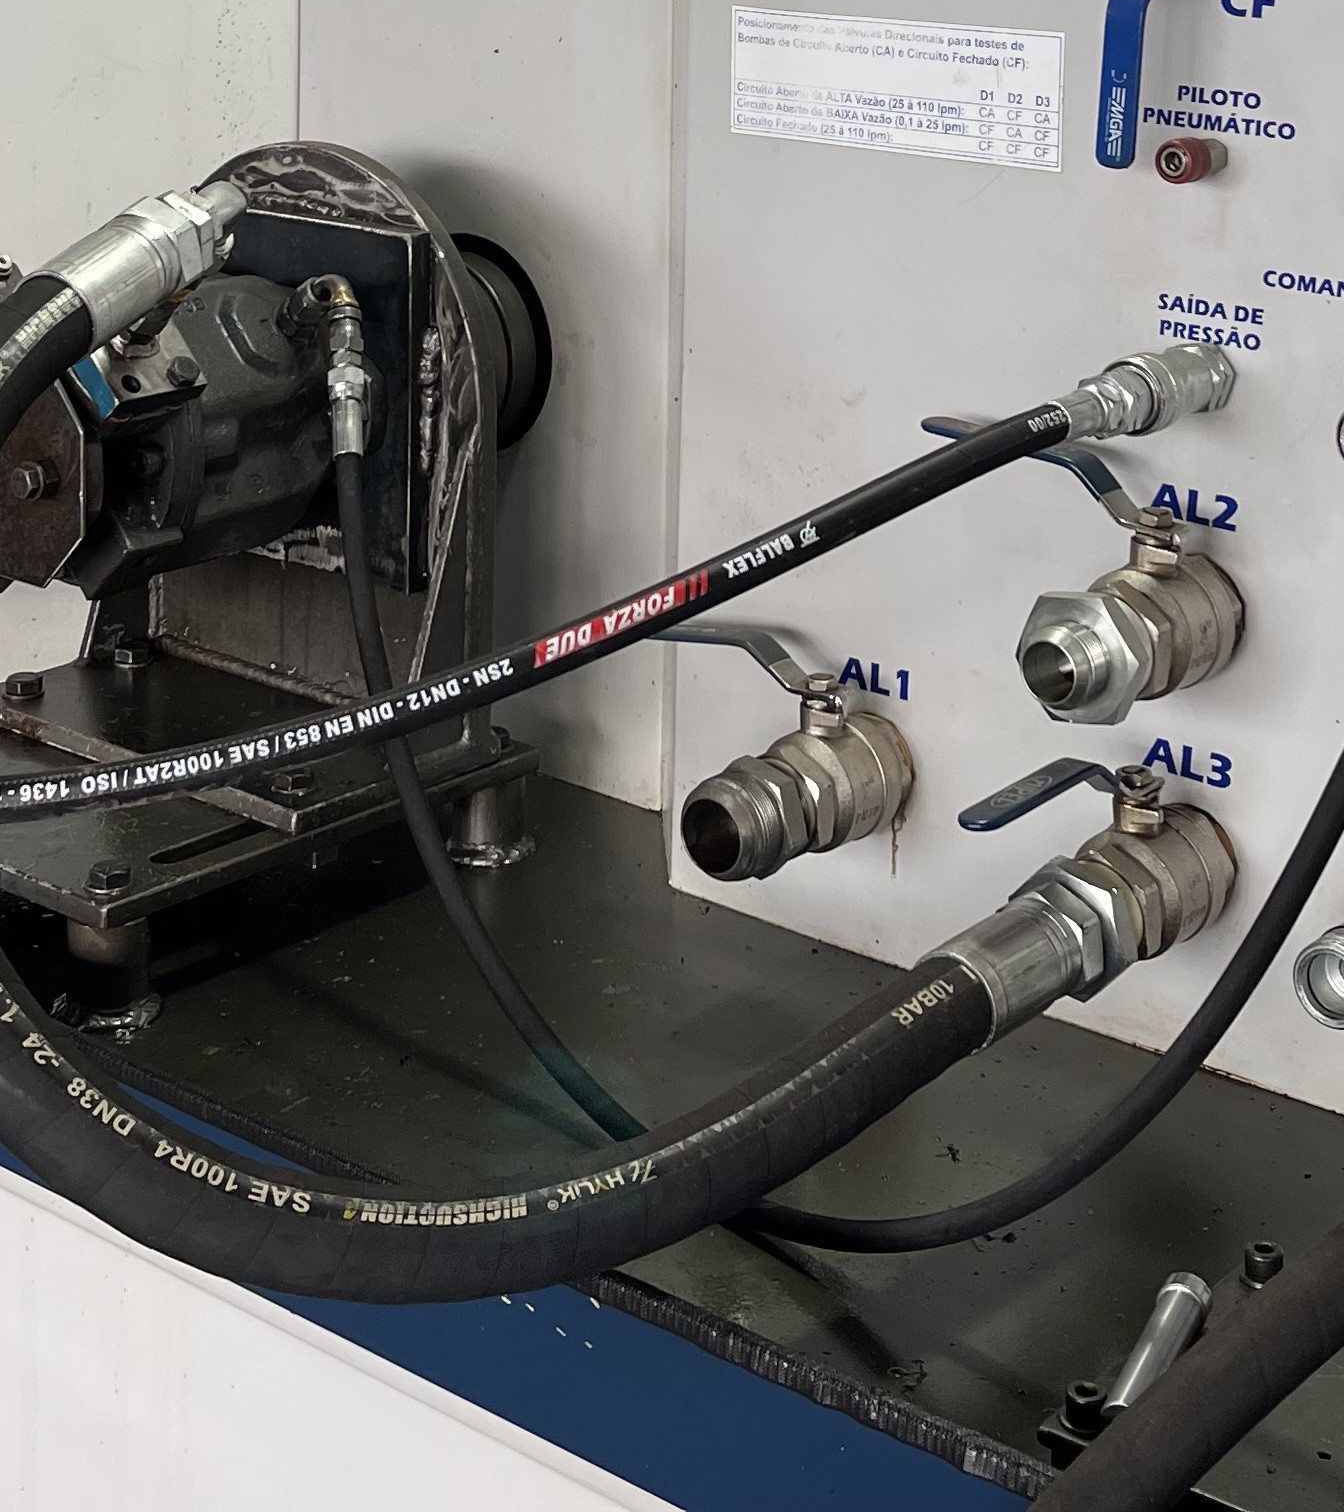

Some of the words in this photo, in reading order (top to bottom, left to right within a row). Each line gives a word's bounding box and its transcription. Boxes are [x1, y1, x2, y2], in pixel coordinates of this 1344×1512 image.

[738, 32, 776, 46] Bombas
[872, 45, 894, 59] (CA)
[907, 48, 949, 62] Circuito
[952, 52, 999, 66] Fechado
[947, 38, 971, 49] para
[974, 38, 1007, 49] testes
[1011, 40, 1025, 51] de
[737, 82, 773, 95] Circuito
[855, 93, 885, 107] Vazão
[889, 98, 904, 111] (25
[917, 101, 934, 112] 110
[980, 90, 994, 101] D1
[1008, 92, 1022, 104] D2
[1035, 96, 1050, 107] D3
[1177, 85, 1260, 109] PILOTO
[861, 111, 892, 124] Vazão
[926, 119, 938, 129] 25
[979, 107, 995, 118] CA
[1007, 110, 1023, 120] CF
[1035, 113, 1050, 124] CA
[1143, 107, 1295, 139] PNEUMÁTICO
[979, 124, 995, 135] CF
[1006, 127, 1023, 138] CA
[1034, 130, 1050, 141] CF
[978, 140, 994, 151] CF
[1006, 143, 1022, 154] CF
[1034, 147, 1050, 158] CF
[1158, 293, 1227, 321] SAÍDA
[1235, 306, 1264, 326] DE
[1159, 319, 1261, 351] PRESSÃO
[1151, 483, 1239, 532] AL2
[722, 533, 795, 578] BALFLEX
[603, 586, 675, 634] FORZA
[545, 622, 592, 663] DUE
[472, 658, 514, 684] 2SN
[837, 657, 911, 702] AL1
[406, 676, 461, 711] DN12
[324, 713, 353, 739] EN
[357, 699, 393, 730] DIN
[228, 738, 269, 765] SAE
[284, 723, 321, 750] 853
[134, 749, 225, 784] 100R2AT
[1142, 738, 1233, 789] AL3
[20, 780, 70, 801] 1436
[81, 771, 118, 795] ISO
[890, 981, 955, 1029] 10BAR
[66, 1076, 137, 1136] DN38
[152, 1138, 241, 1193] 100R4
[248, 1179, 312, 1213] SAE
[557, 1168, 624, 1202] HYLIK
